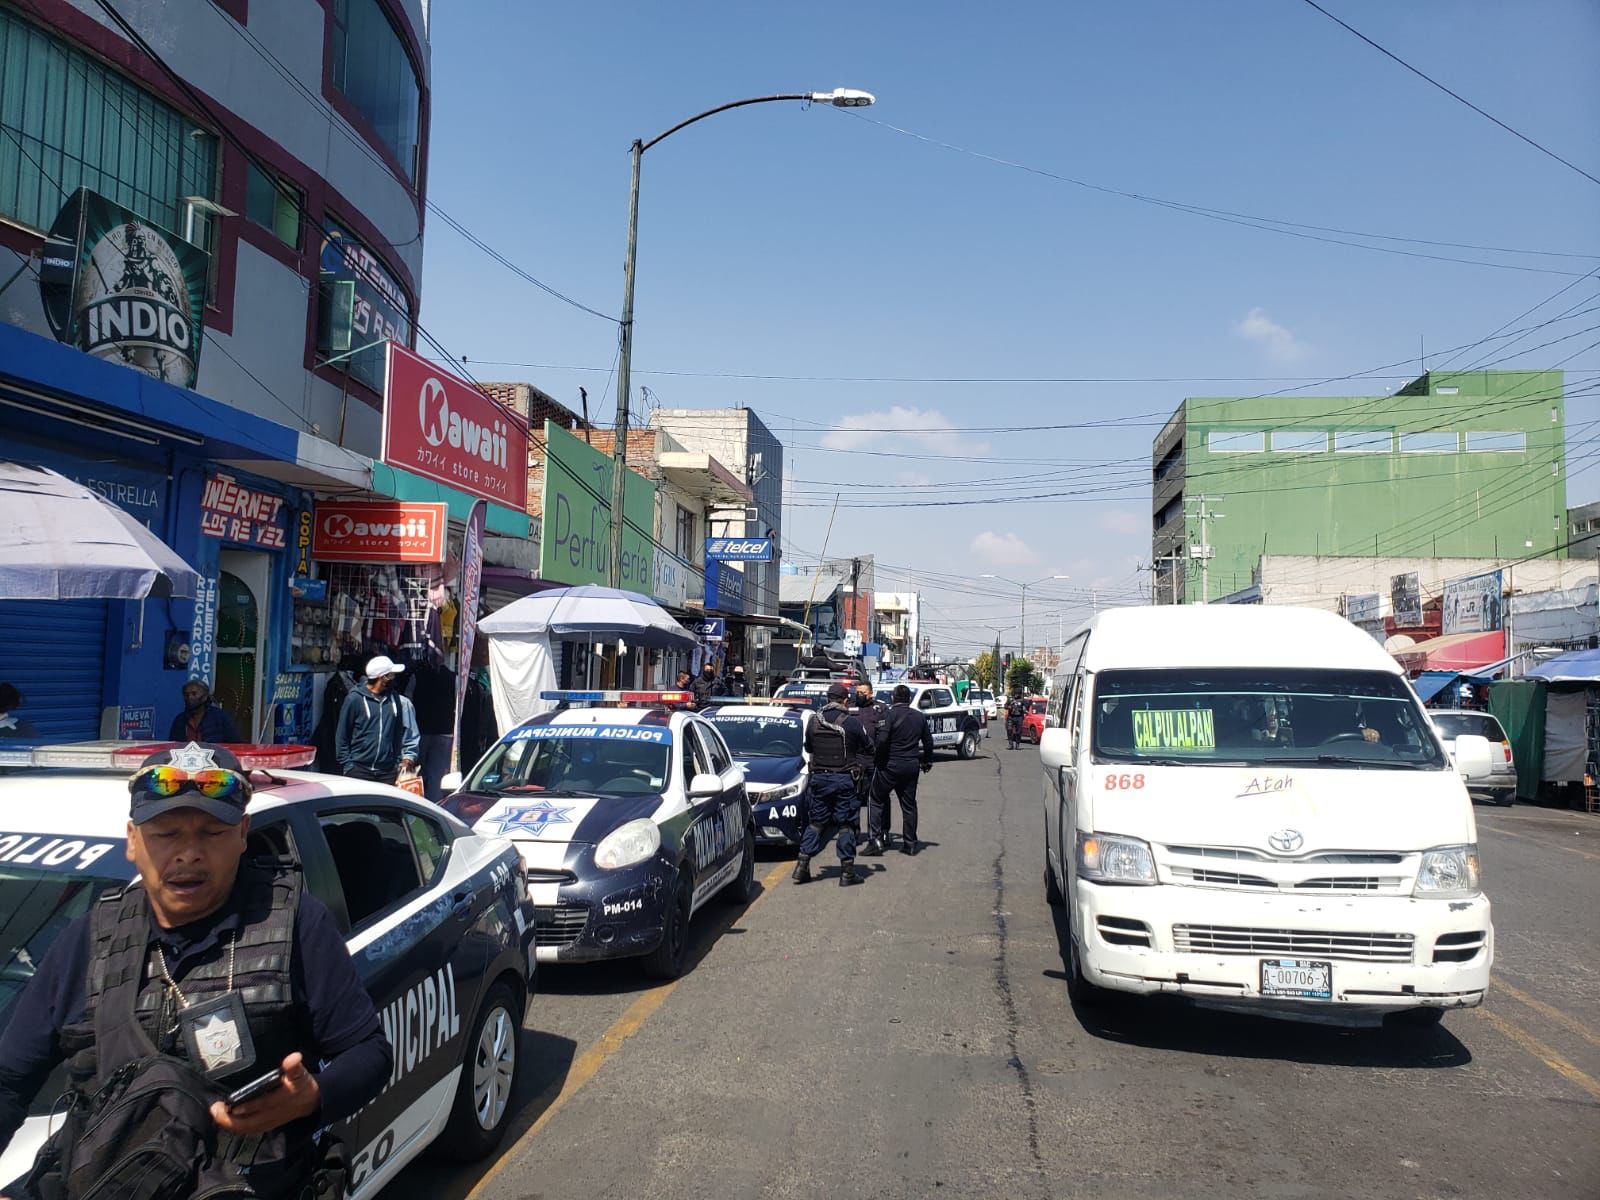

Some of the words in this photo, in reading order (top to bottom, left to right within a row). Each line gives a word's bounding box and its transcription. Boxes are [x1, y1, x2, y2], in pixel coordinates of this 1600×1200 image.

[89, 300, 189, 350] INDIO
[419, 377, 507, 469] Kawaii
[417, 447, 446, 471] カワイイ
[452, 462, 479, 483] store
[484, 474, 507, 495] カワイイ
[87, 478, 158, 508] ESTRELLA
[201, 472, 284, 522] INTERNET
[201, 511, 228, 537] LOS
[324, 514, 427, 538] Kawaii
[554, 492, 648, 585] Perfuería
[723, 540, 769, 554] telcel
[124, 711, 151, 721] NUEVA
[1134, 711, 1213, 748] CALPULALPAN
[1105, 773, 1146, 791] 868
[768, 806, 779, 819] A
[782, 804, 797, 817] 40
[604, 898, 643, 916] PM-014
[1263, 969, 1329, 988] A-00706-X
[366, 961, 461, 1103] NICIPAL
